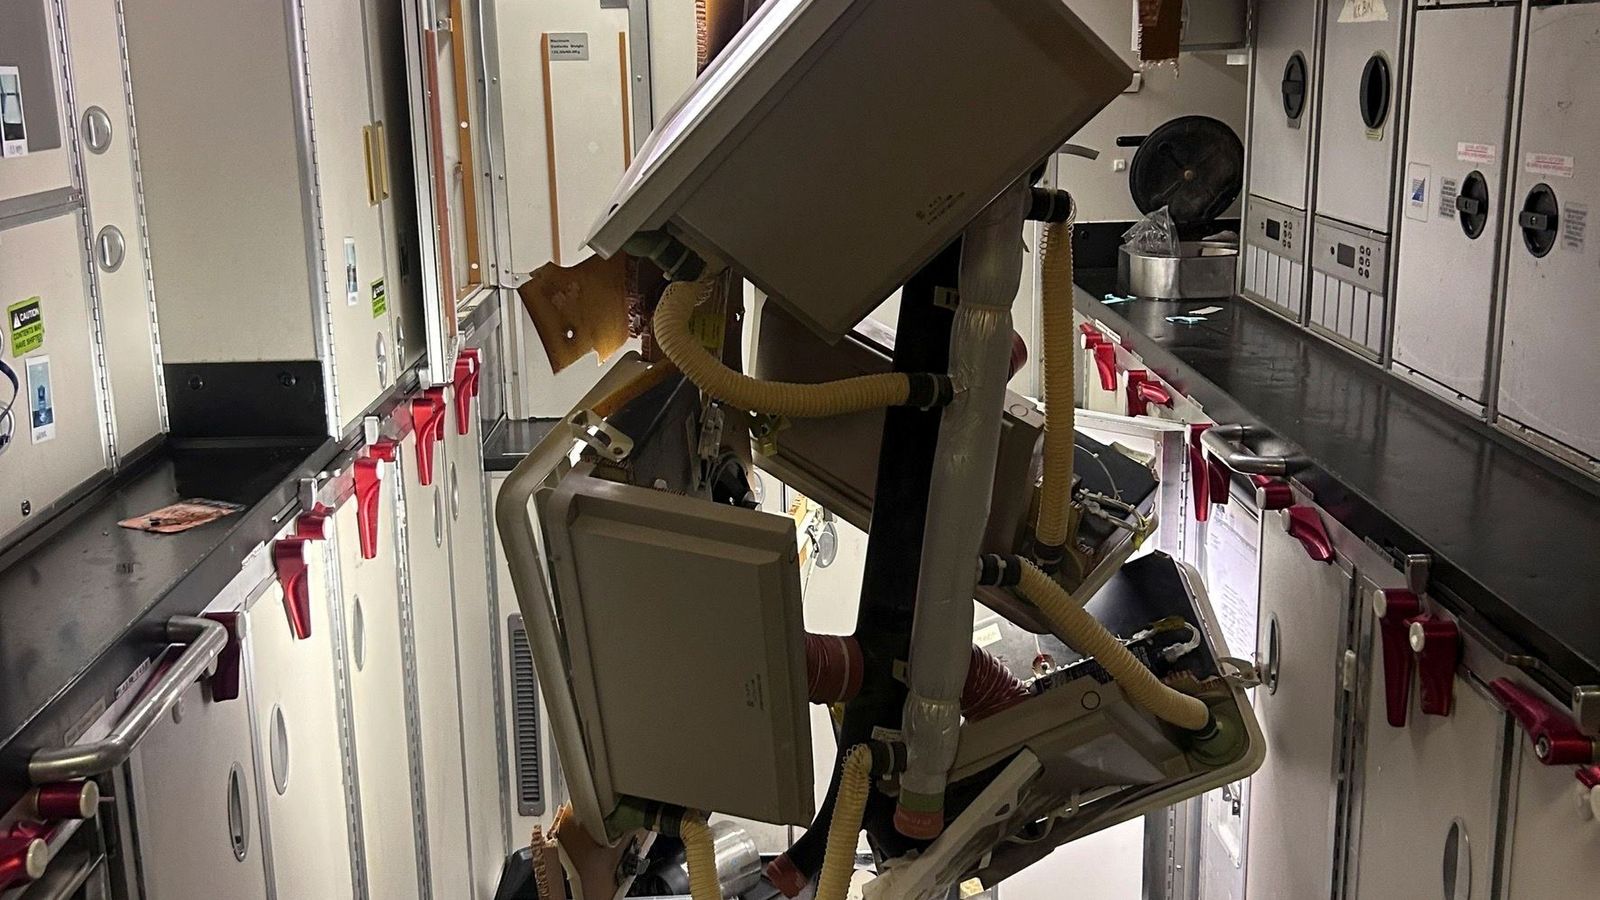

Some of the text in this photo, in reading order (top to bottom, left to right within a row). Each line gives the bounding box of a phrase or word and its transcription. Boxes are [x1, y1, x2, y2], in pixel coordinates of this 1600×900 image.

[19, 308, 40, 321] CAUTION
[13, 326, 34, 340] CONTENTS
[15, 339, 26, 350] HAVE
